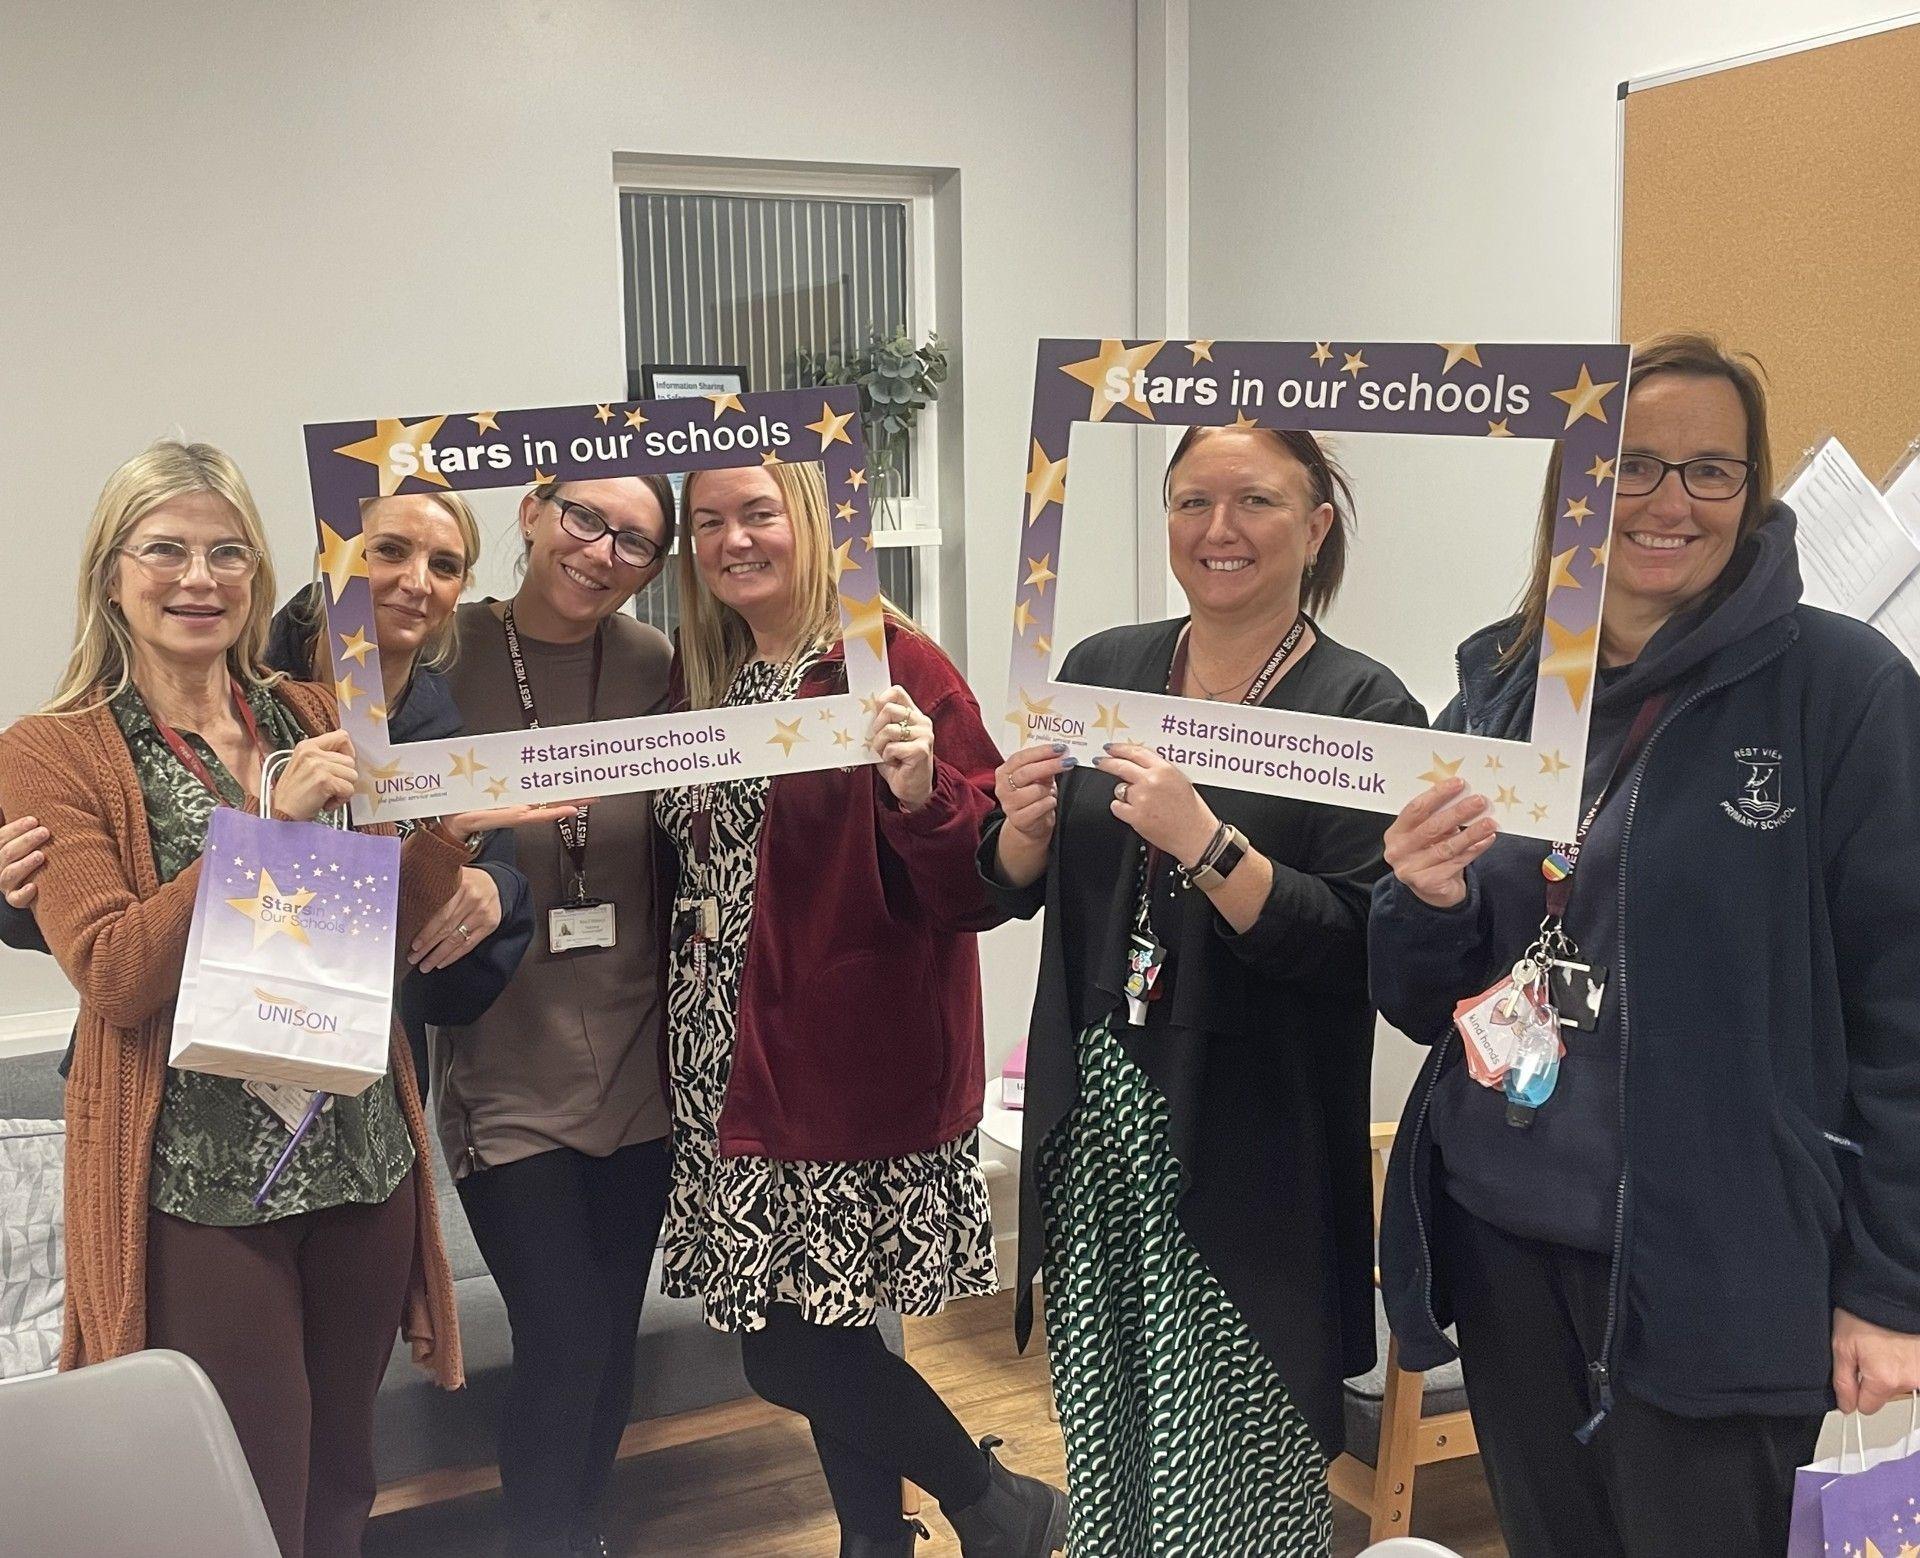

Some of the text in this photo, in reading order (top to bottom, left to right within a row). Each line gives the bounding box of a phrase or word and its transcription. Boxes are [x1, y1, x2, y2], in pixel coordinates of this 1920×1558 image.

[656, 381, 726, 393] Information Sharing
[1104, 366, 1531, 415] Stars in our schools
[389, 415, 791, 476] Stars in our schools
[512, 659, 527, 683] VIEW
[1246, 680, 1265, 700] VIEW
[1260, 647, 1288, 680] PRIMARY
[518, 684, 534, 710] WEST
[1027, 713, 1085, 736] UNISON
[1161, 714, 1374, 762] #starsinourschools
[520, 725, 726, 764] #starsinourschools
[375, 773, 441, 794] UNISON
[520, 747, 742, 790] starsinourschools.uk
[1156, 745, 1387, 794] starsinourschools.uk
[1577, 807, 1597, 837] VIEW
[1720, 800, 1797, 830] PRIMARY SCHOOL
[260, 909, 345, 934] Our Schools
[258, 1003, 337, 1032] UNISON
[1469, 1013, 1500, 1065] kind hands
